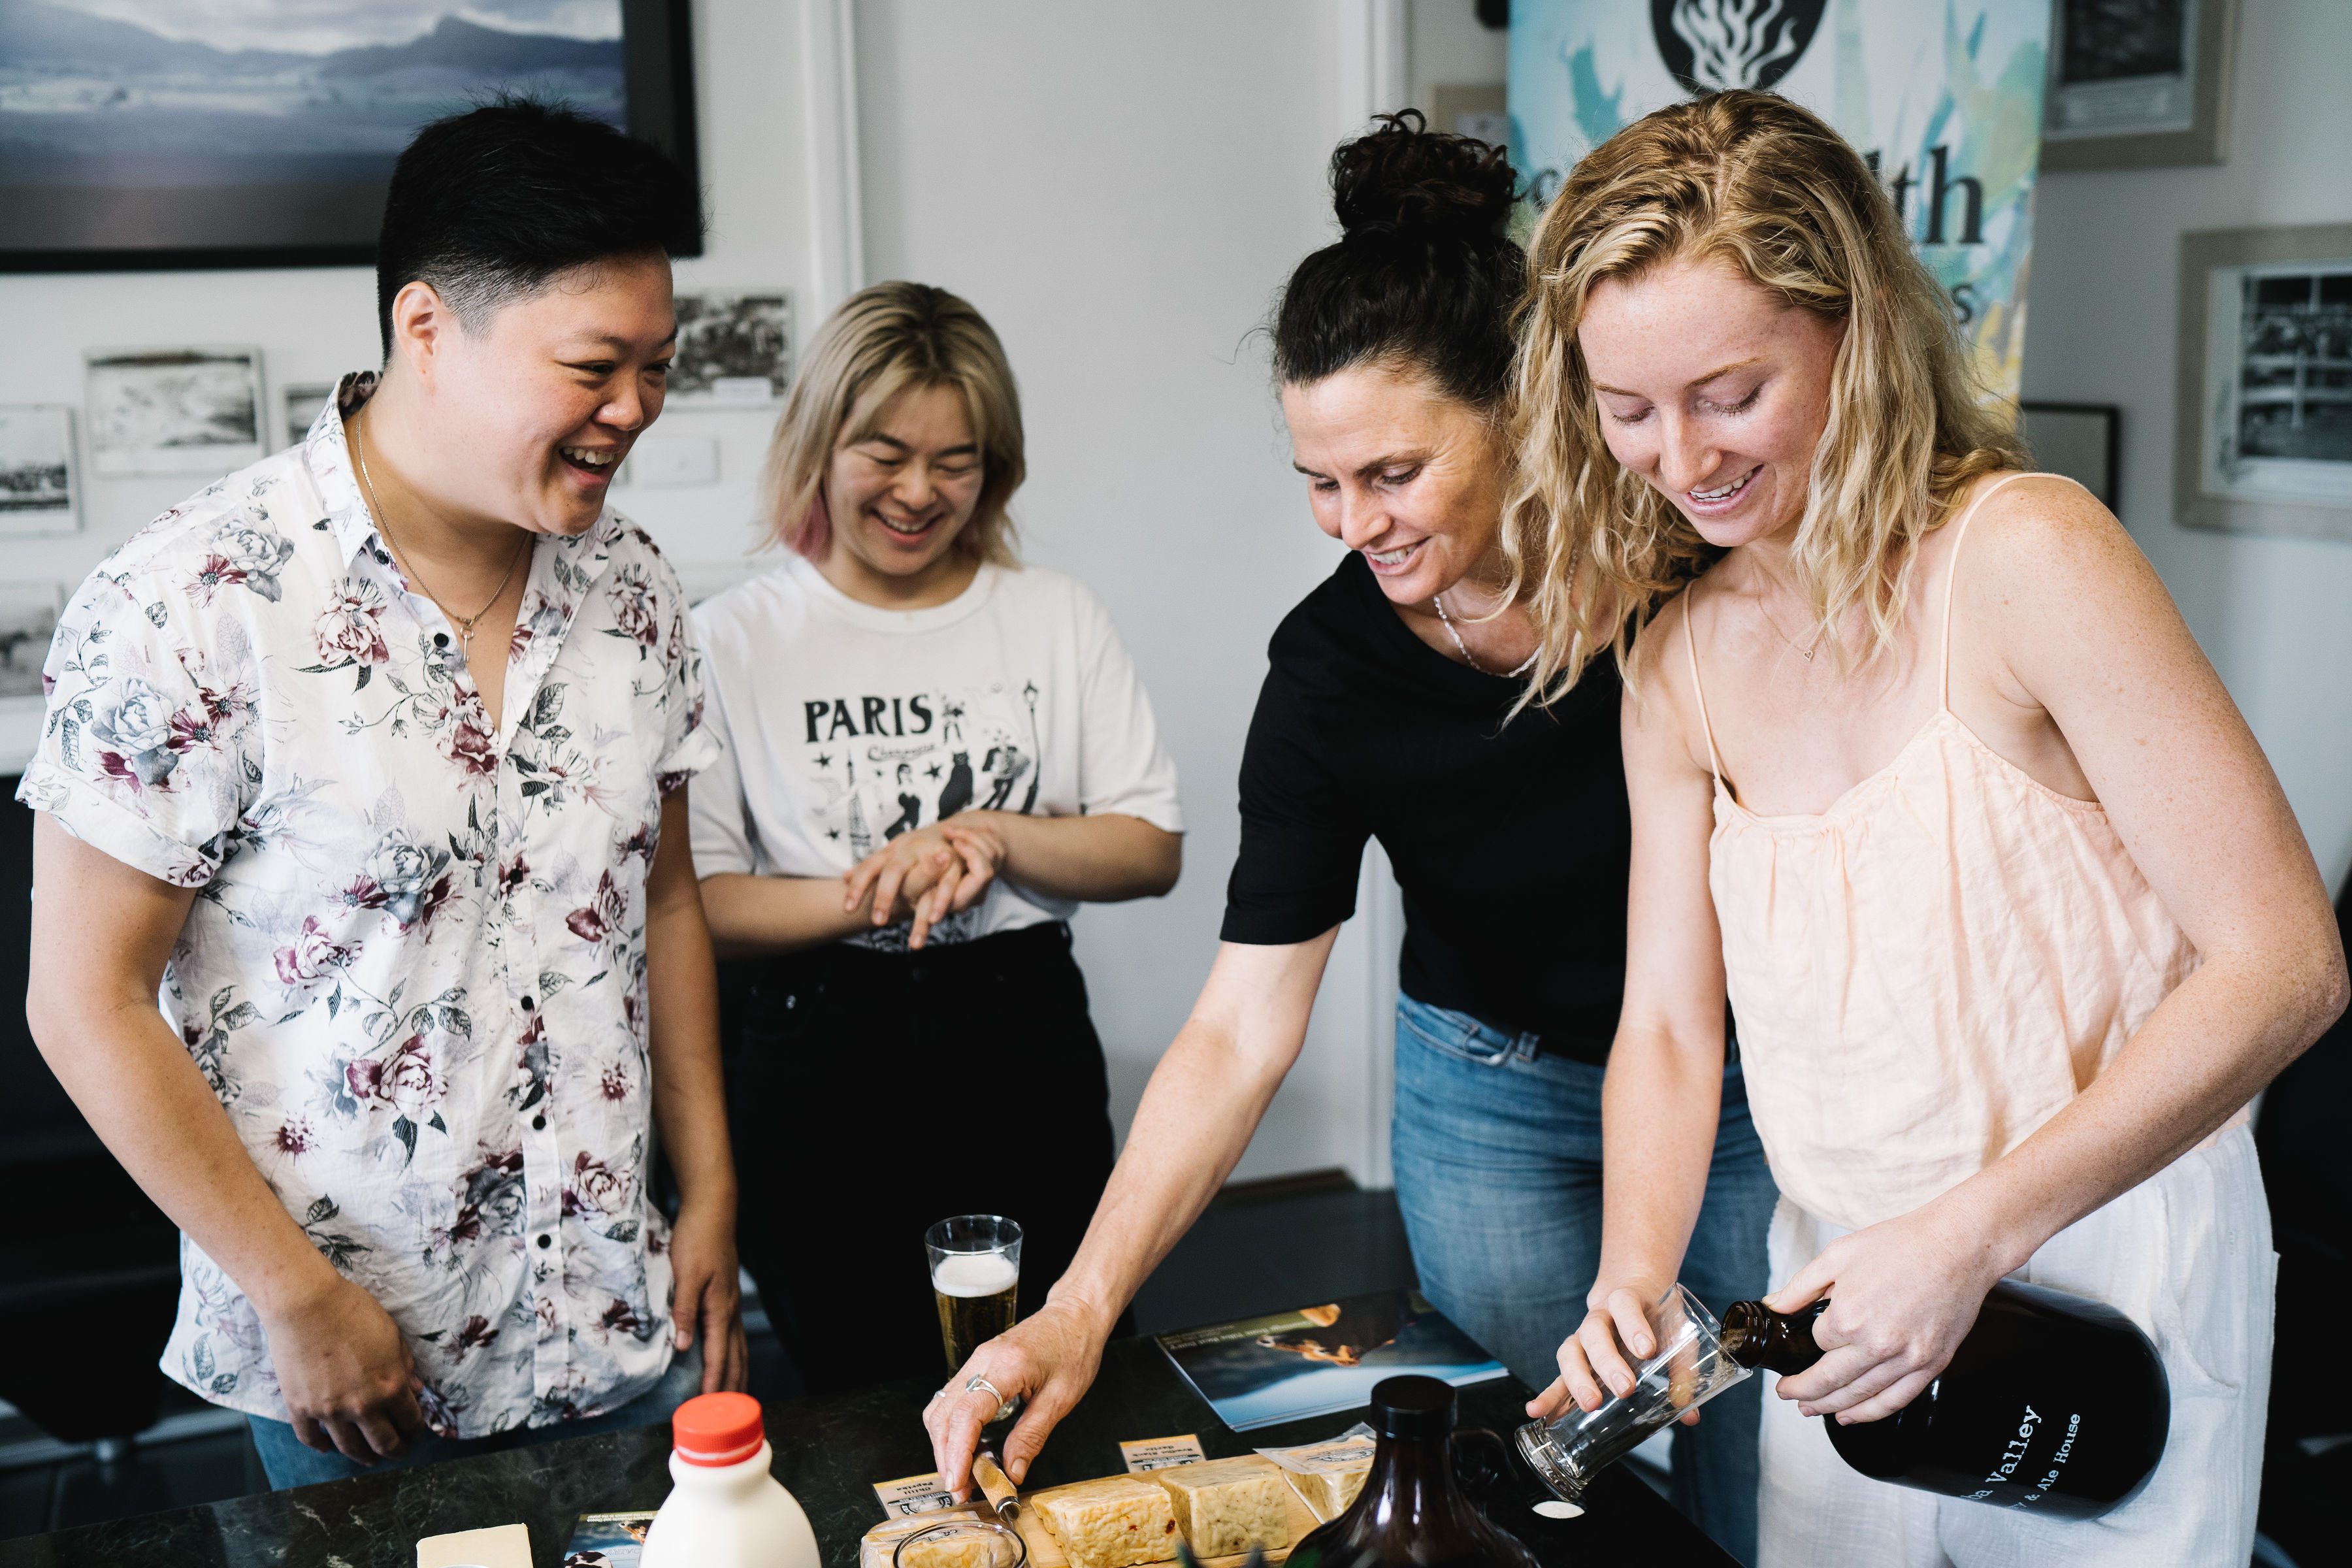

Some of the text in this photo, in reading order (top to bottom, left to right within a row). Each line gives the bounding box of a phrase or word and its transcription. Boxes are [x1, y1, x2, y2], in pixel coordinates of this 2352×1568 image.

[805, 694, 932, 742] PARIS
[1985, 1405, 2042, 1482] Valley
[2037, 1470, 2059, 1491] Ale
[2053, 1414, 2080, 1463] House
